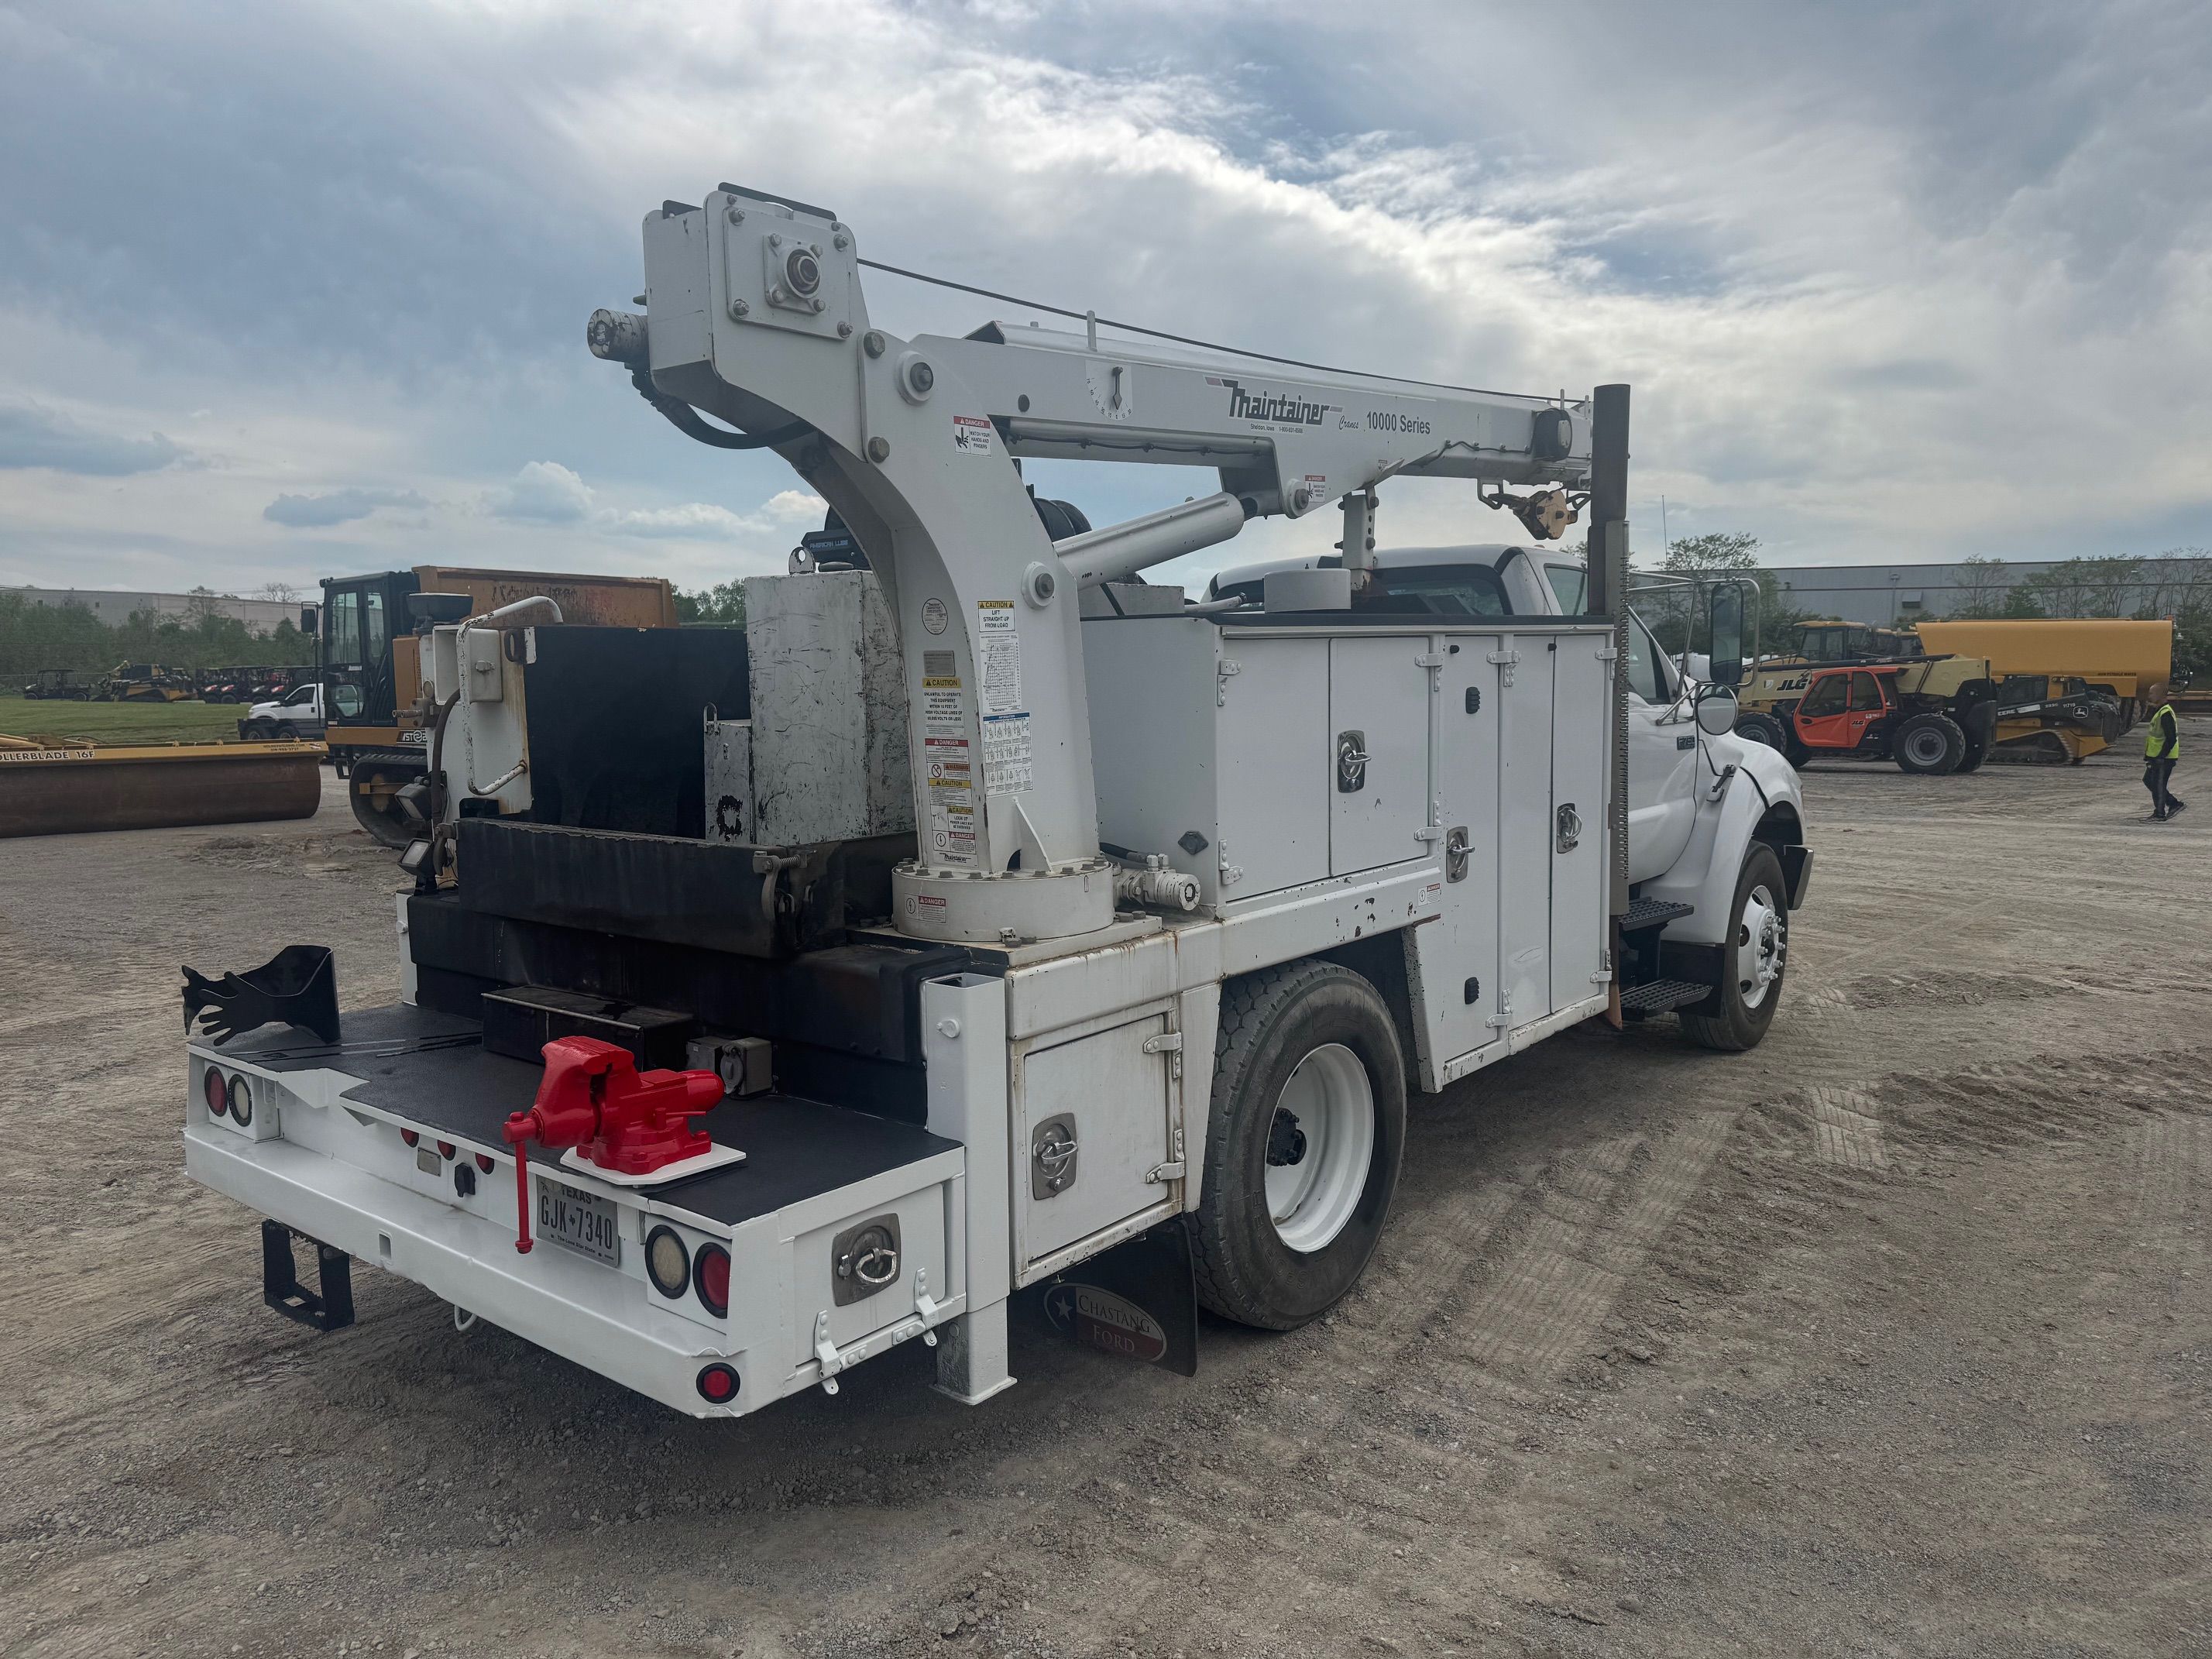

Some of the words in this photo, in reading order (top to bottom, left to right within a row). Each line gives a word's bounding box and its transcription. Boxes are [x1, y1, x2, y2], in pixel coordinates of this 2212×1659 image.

[1339, 415, 1359, 430] Cranes
[1367, 411, 1396, 431] 10000
[1400, 415, 1431, 434] Series
[1776, 678, 1808, 691] JLG
[562, 1184, 592, 1204] TEXAS
[541, 1195, 567, 1233] GJK
[575, 1207, 613, 1250] 7340
[585, 1245, 596, 1254] State
[1078, 1295, 1150, 1333] CHASTANG
[1093, 1324, 1135, 1352] FORD
